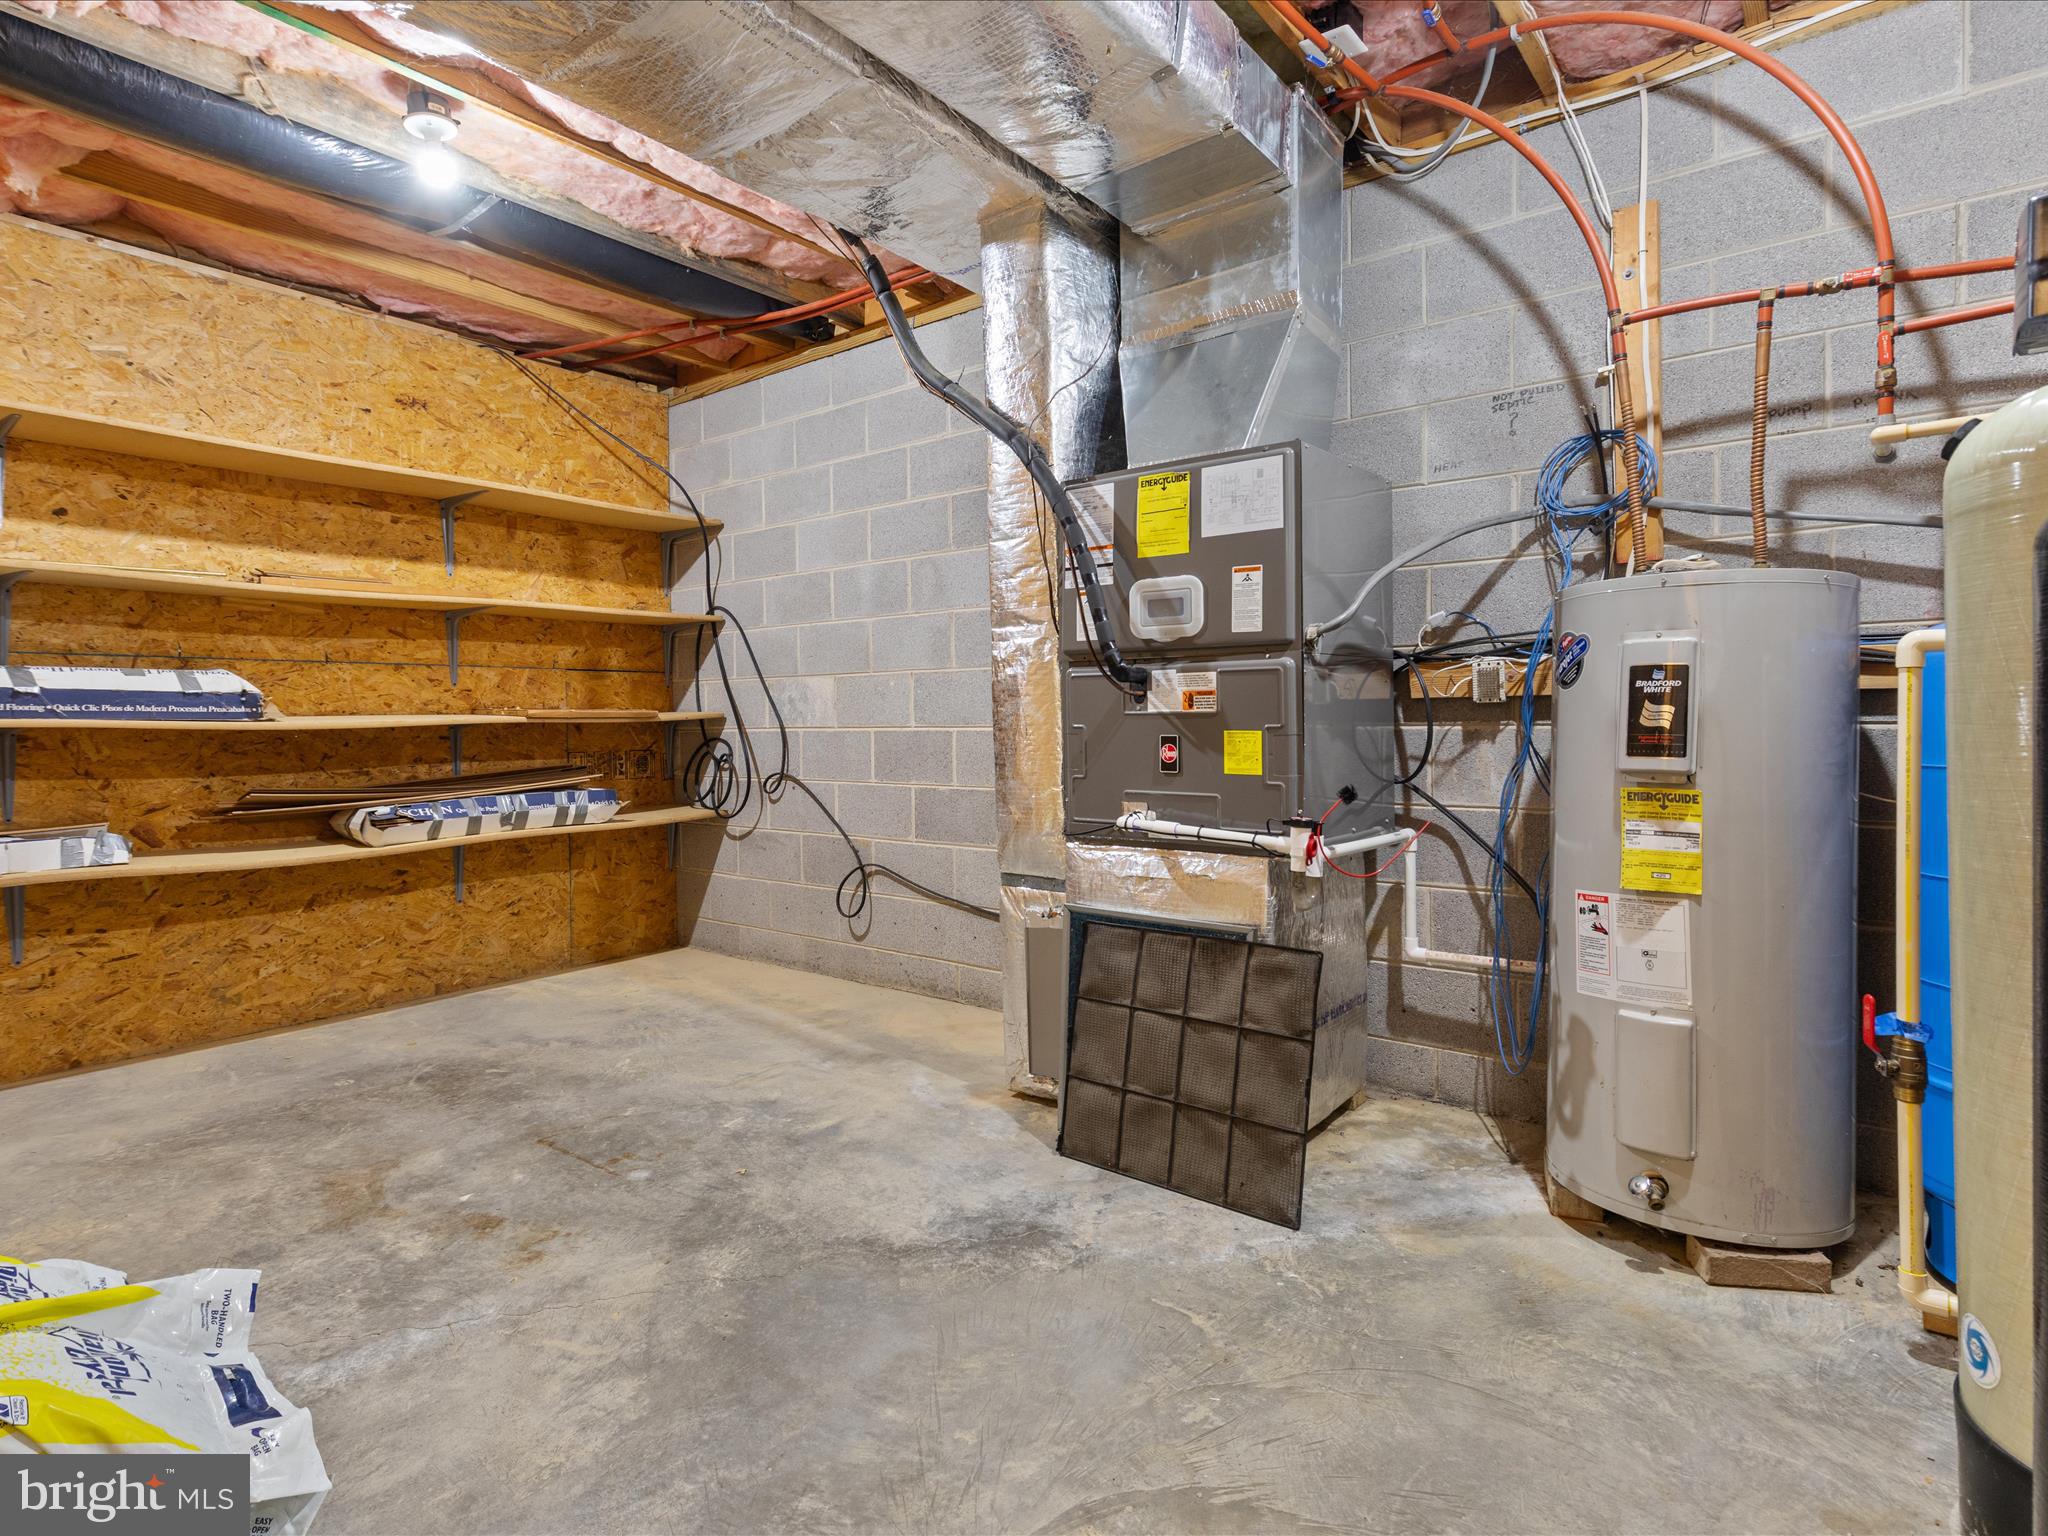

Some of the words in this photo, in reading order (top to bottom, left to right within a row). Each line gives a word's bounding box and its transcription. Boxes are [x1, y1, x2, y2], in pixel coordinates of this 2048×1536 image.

[1492, 392, 1515, 403] NOT
[1520, 384, 1565, 397] PULLED
[1491, 396, 1536, 413] SEPTIC
[1140, 473, 1188, 490] ENERGYGUIDE
[5, 703, 45, 713] Flooring
[53, 703, 81, 712] Quick
[82, 703, 100, 712] Clic
[101, 704, 123, 712] Pisos
[124, 704, 135, 712] de
[135, 704, 167, 712] Madera
[168, 704, 208, 712] Procesada
[1627, 792, 1700, 805] ENERGYGUIDE
[399, 805, 454, 817] SCHN
[210, 1310, 219, 1326] BAG
[215, 1288, 232, 1349] TWO-HANDLED
[259, 1437, 272, 1454] OPEN
[254, 1517, 274, 1526] EASY
[251, 1526, 271, 1535] OPEN
